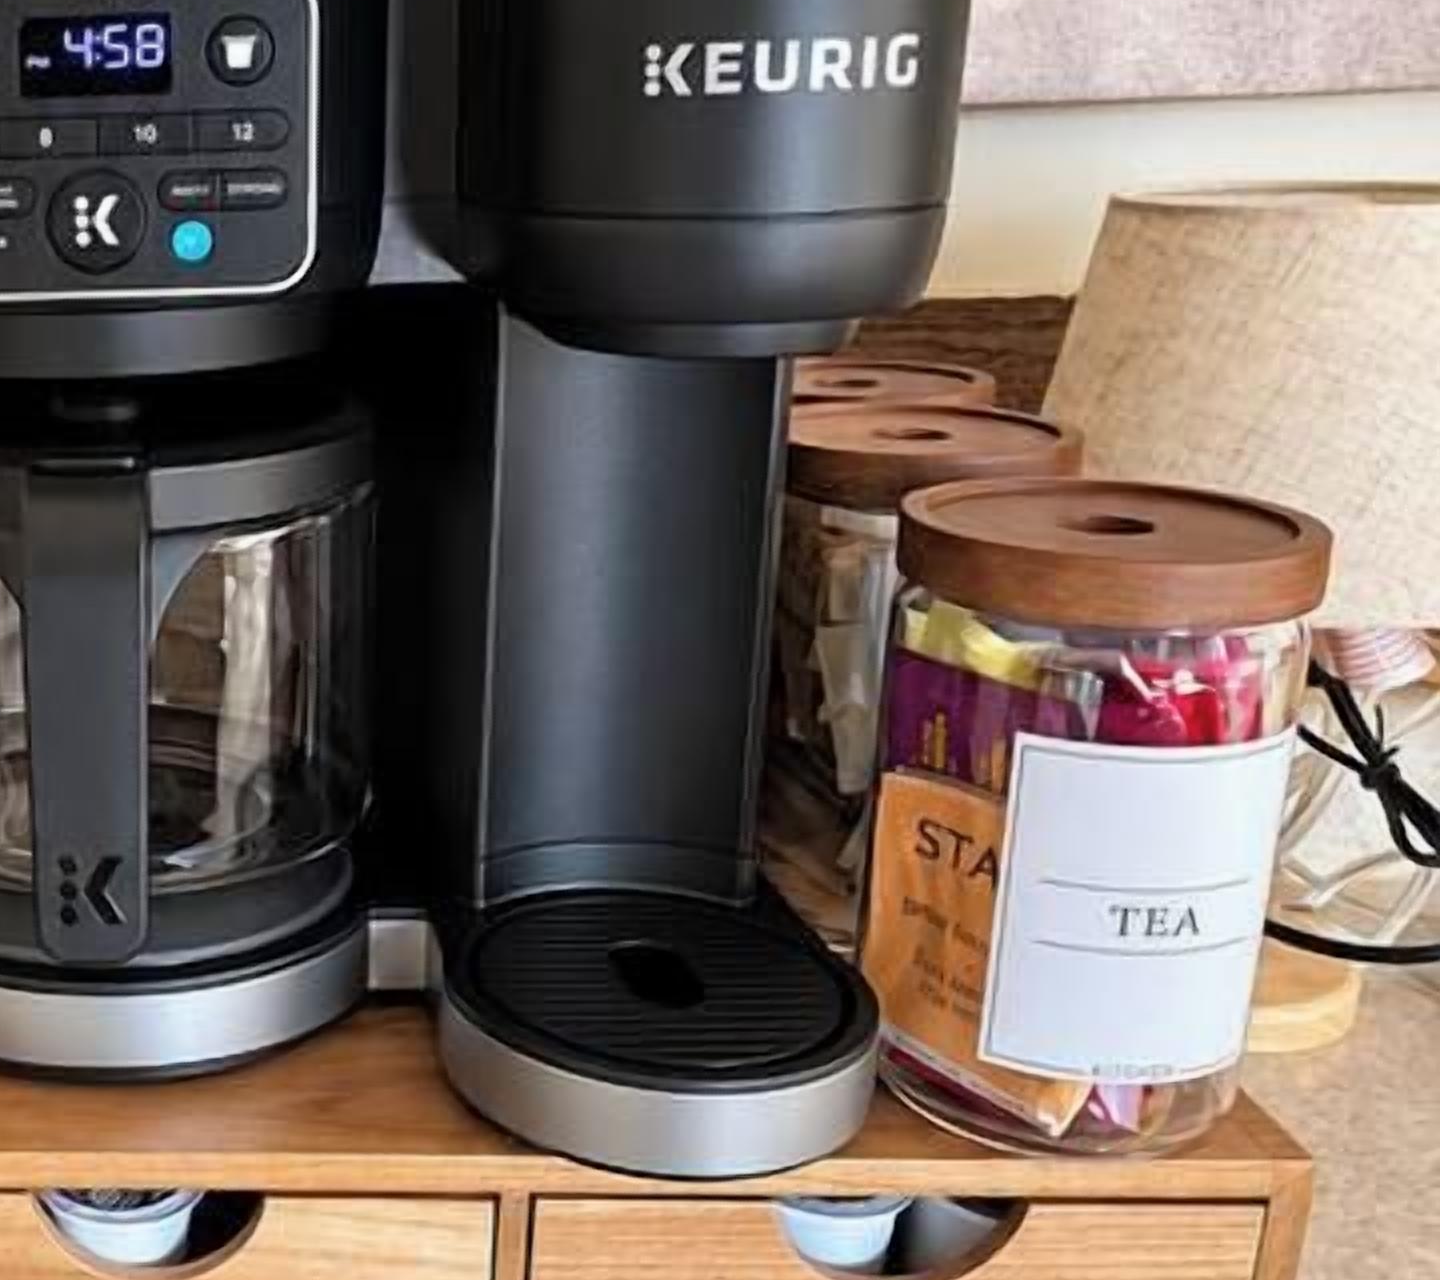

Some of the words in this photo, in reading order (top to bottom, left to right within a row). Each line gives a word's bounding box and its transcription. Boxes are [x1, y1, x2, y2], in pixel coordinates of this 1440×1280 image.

[63, 23, 164, 68] 4:58
[643, 33, 920, 97] KEURIG
[1109, 905, 1200, 936] TEA
